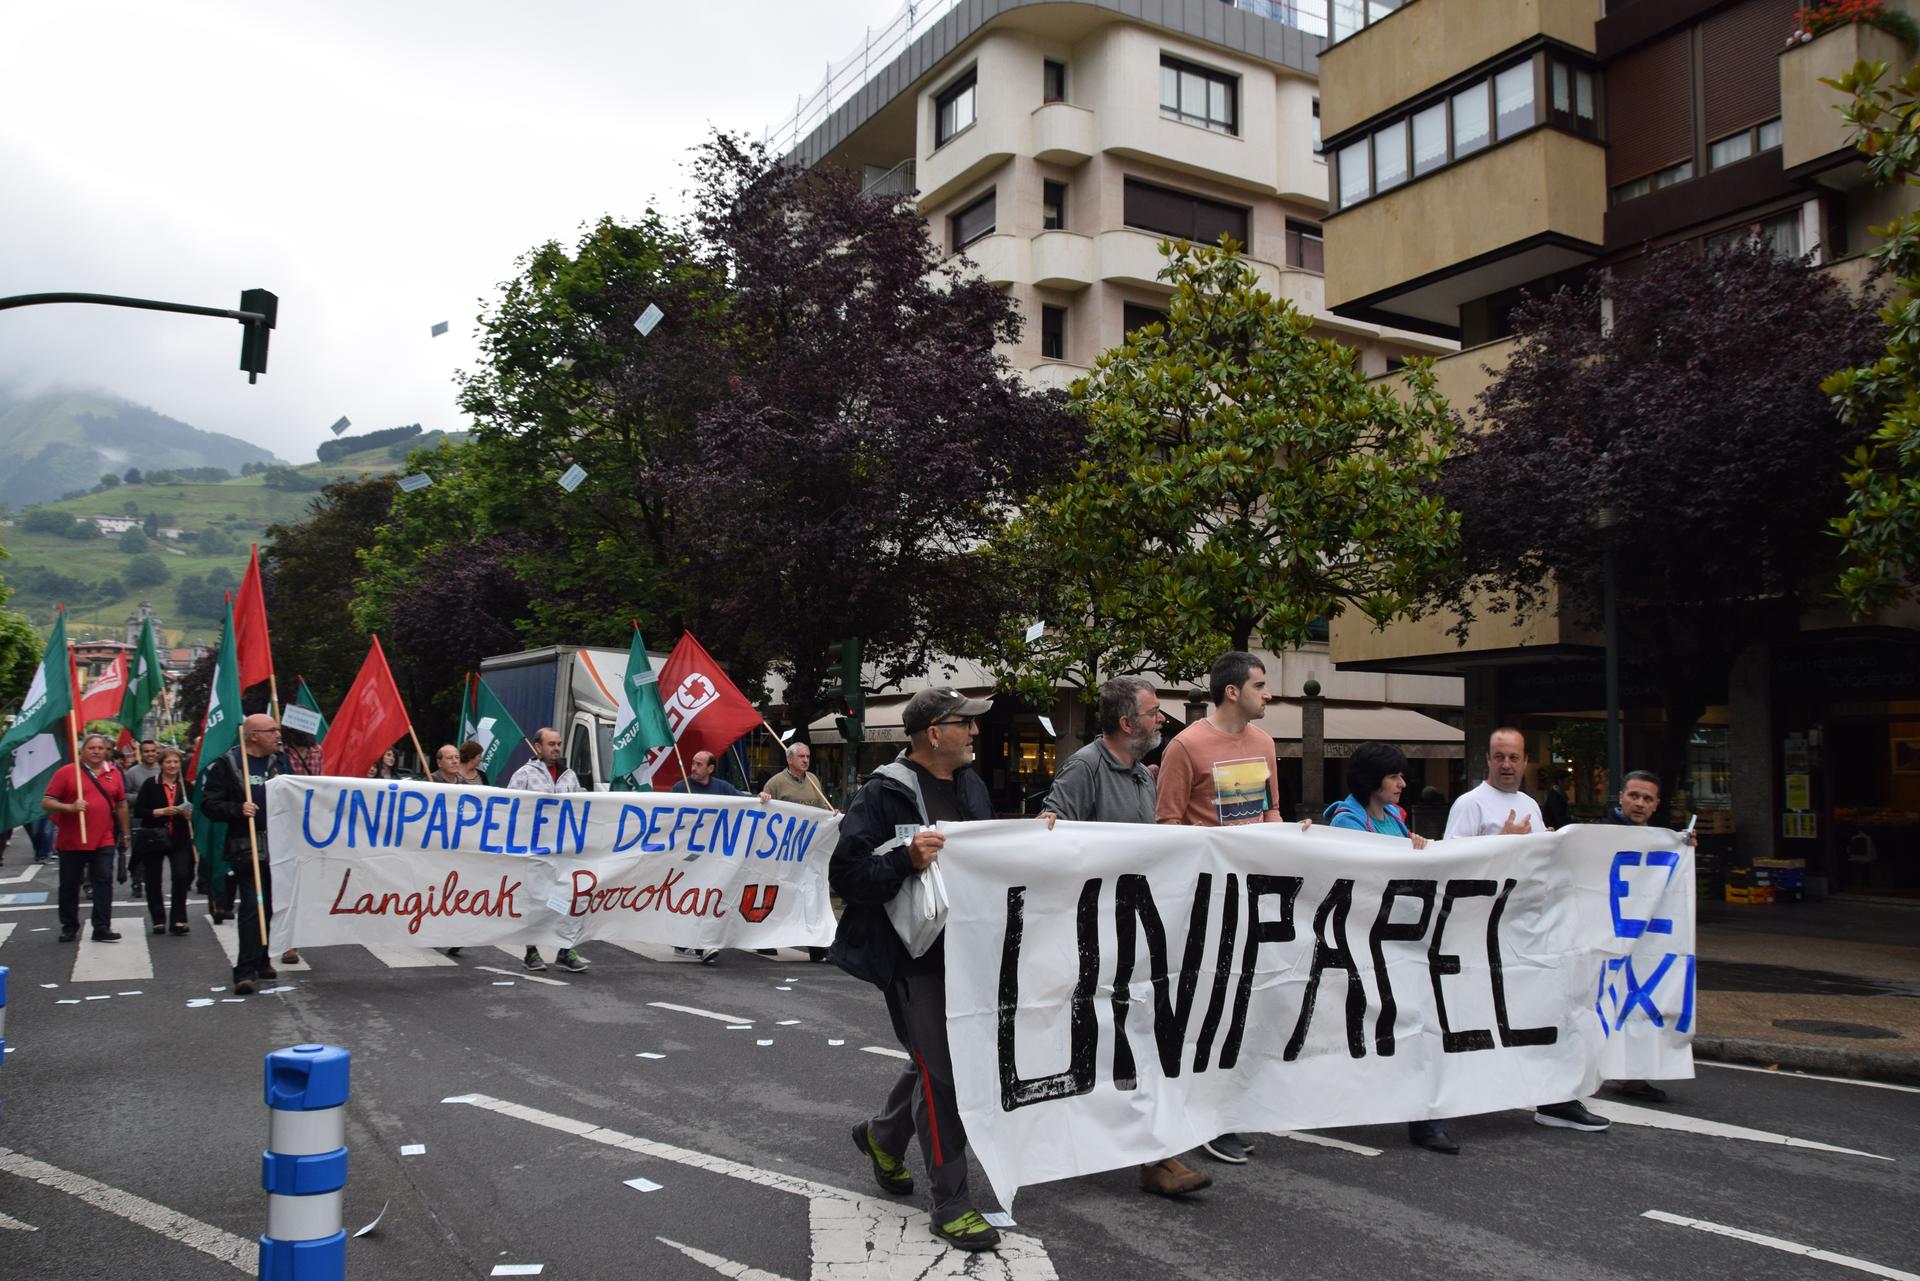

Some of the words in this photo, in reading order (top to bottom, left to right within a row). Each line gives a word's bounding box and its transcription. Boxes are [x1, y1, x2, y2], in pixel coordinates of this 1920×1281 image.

[612, 804, 818, 862] DEFENTSAN
[1609, 851, 1680, 939] EZ
[997, 872, 1559, 1112] UNIPAPEL
